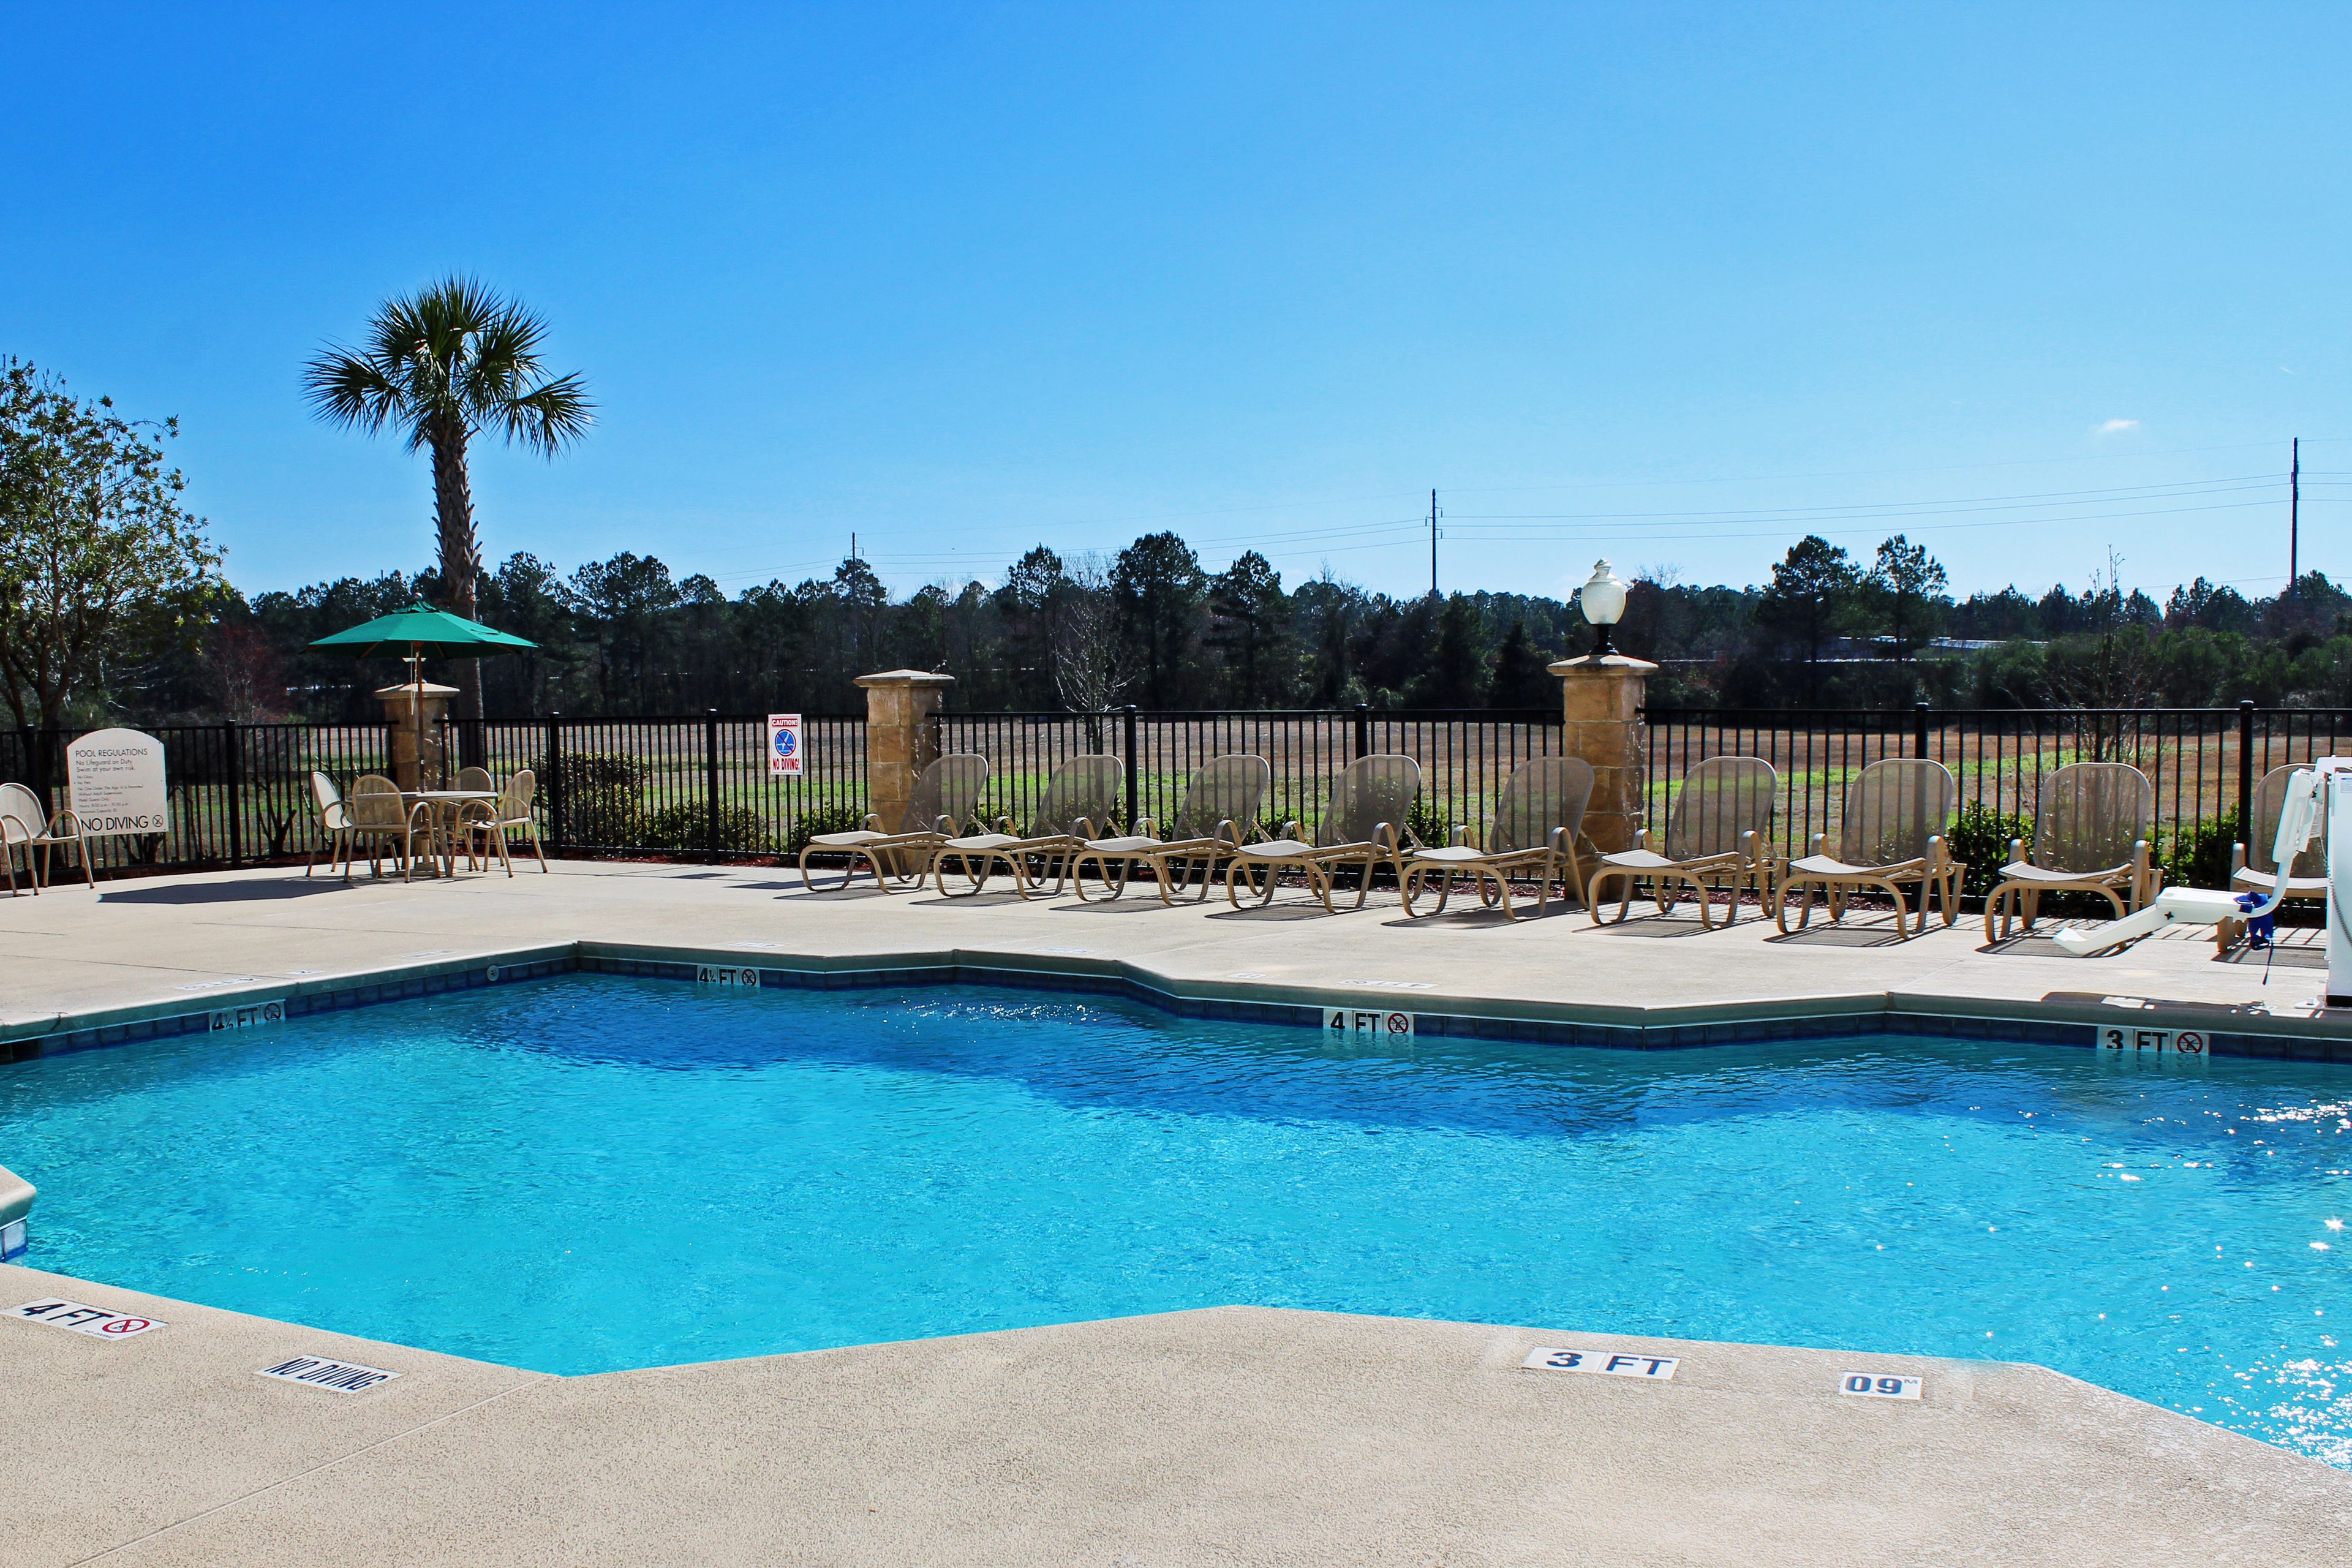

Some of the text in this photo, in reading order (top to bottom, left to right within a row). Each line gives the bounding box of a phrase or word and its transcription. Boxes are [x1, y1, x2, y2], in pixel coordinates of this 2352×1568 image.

[773, 758, 800, 770] NO DIVING!
[80, 815, 148, 831] NO DIVING
[719, 968, 737, 984] FT
[236, 1007, 258, 1027] FT
[1330, 1012, 1381, 1032] 4 FT
[2106, 1029, 2168, 1052] 3 FT
[22, 1303, 116, 1327] 4 FT
[264, 1357, 389, 1391] NO DIVING
[1547, 1352, 1673, 1376] 3 FT
